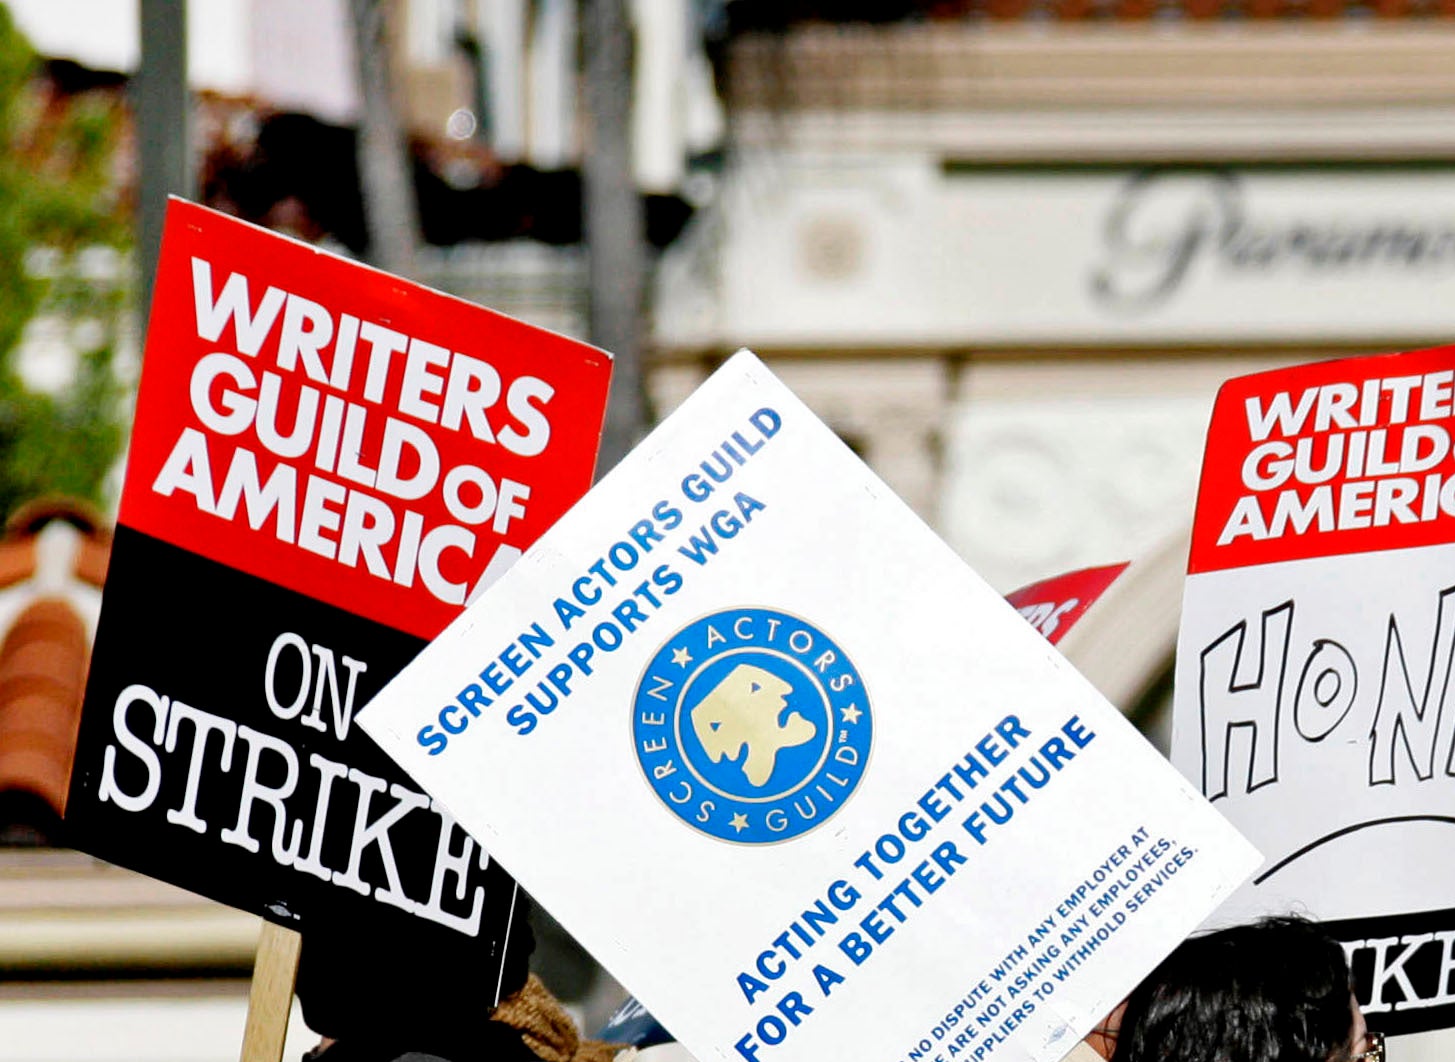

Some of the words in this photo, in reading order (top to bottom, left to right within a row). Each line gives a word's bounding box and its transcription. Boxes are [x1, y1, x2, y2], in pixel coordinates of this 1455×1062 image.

[189, 352, 441, 500] GUILD
[442, 463, 531, 534] OF
[190, 256, 556, 457] WRITERS
[1241, 426, 1450, 491] GUILD
[416, 621, 556, 757] SCREEN
[552, 500, 683, 632] ACTORS
[680, 407, 782, 503] GUILD
[505, 564, 684, 736] SUPPORTS
[677, 492, 766, 566] WGA
[706, 616, 854, 692] ACTORS
[264, 631, 367, 742] ON
[641, 675, 716, 823] SCREEN
[98, 684, 491, 938] STRIKE
[735, 879, 863, 1006] ACTING
[852, 714, 1032, 881] TOGETHER
[765, 746, 859, 832] GUILD
[812, 963, 846, 998] A
[837, 840, 969, 967] BETTER
[961, 715, 1097, 846] FUTURE
[907, 1038, 933, 1062] NO
[931, 980, 992, 1041] DISPUTE
[989, 944, 1029, 982] WITH
[1027, 917, 1056, 947] ANY
[1055, 844, 1130, 919] EMPLOYER
[1131, 827, 1148, 847] AT
[947, 1026, 979, 1057] ARE
[975, 995, 1007, 1027] NOT
[1006, 944, 1062, 999] ASKING
[1060, 916, 1089, 946] ANY
[1088, 838, 1177, 918] EMPLOYEES,
[1033, 981, 1055, 1001] TO
[1052, 911, 1127, 982] WITHHOLD
[1125, 846, 1199, 912] SERVICES.
